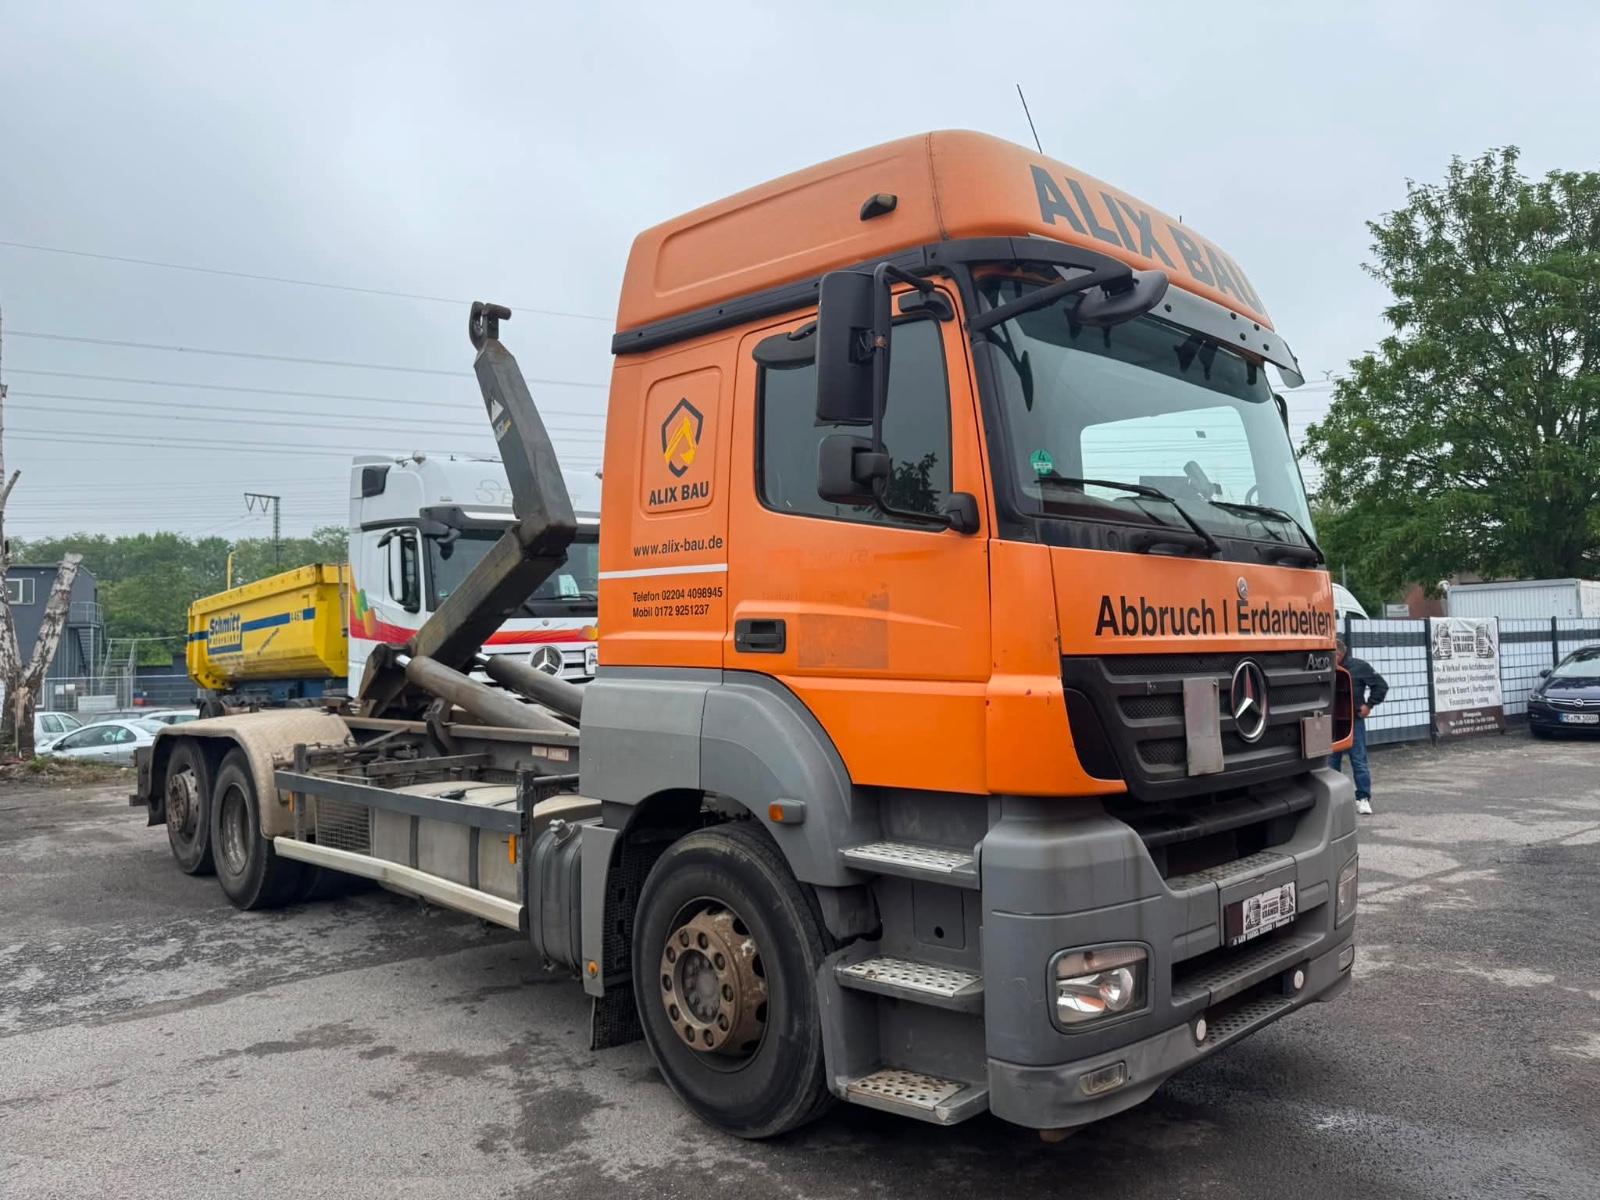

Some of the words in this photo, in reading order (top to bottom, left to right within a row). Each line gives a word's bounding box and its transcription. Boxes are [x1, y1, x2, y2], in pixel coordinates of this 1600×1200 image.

[1030, 164, 1177, 270] ALIX
[1166, 223, 1266, 316] BAU
[649, 486, 678, 506] ALIX
[681, 480, 709, 501] BAU
[633, 535, 723, 557] www.alix-bau.de
[633, 591, 660, 603] Telefon
[661, 589, 685, 601] 02204
[687, 586, 723, 599] 4098945
[632, 606, 653, 618] Mobil
[654, 605, 674, 617] 0172
[675, 604, 710, 616] 9251237
[1095, 594, 1216, 637] Abbruch
[1237, 599, 1333, 638] Erdarbeiten
